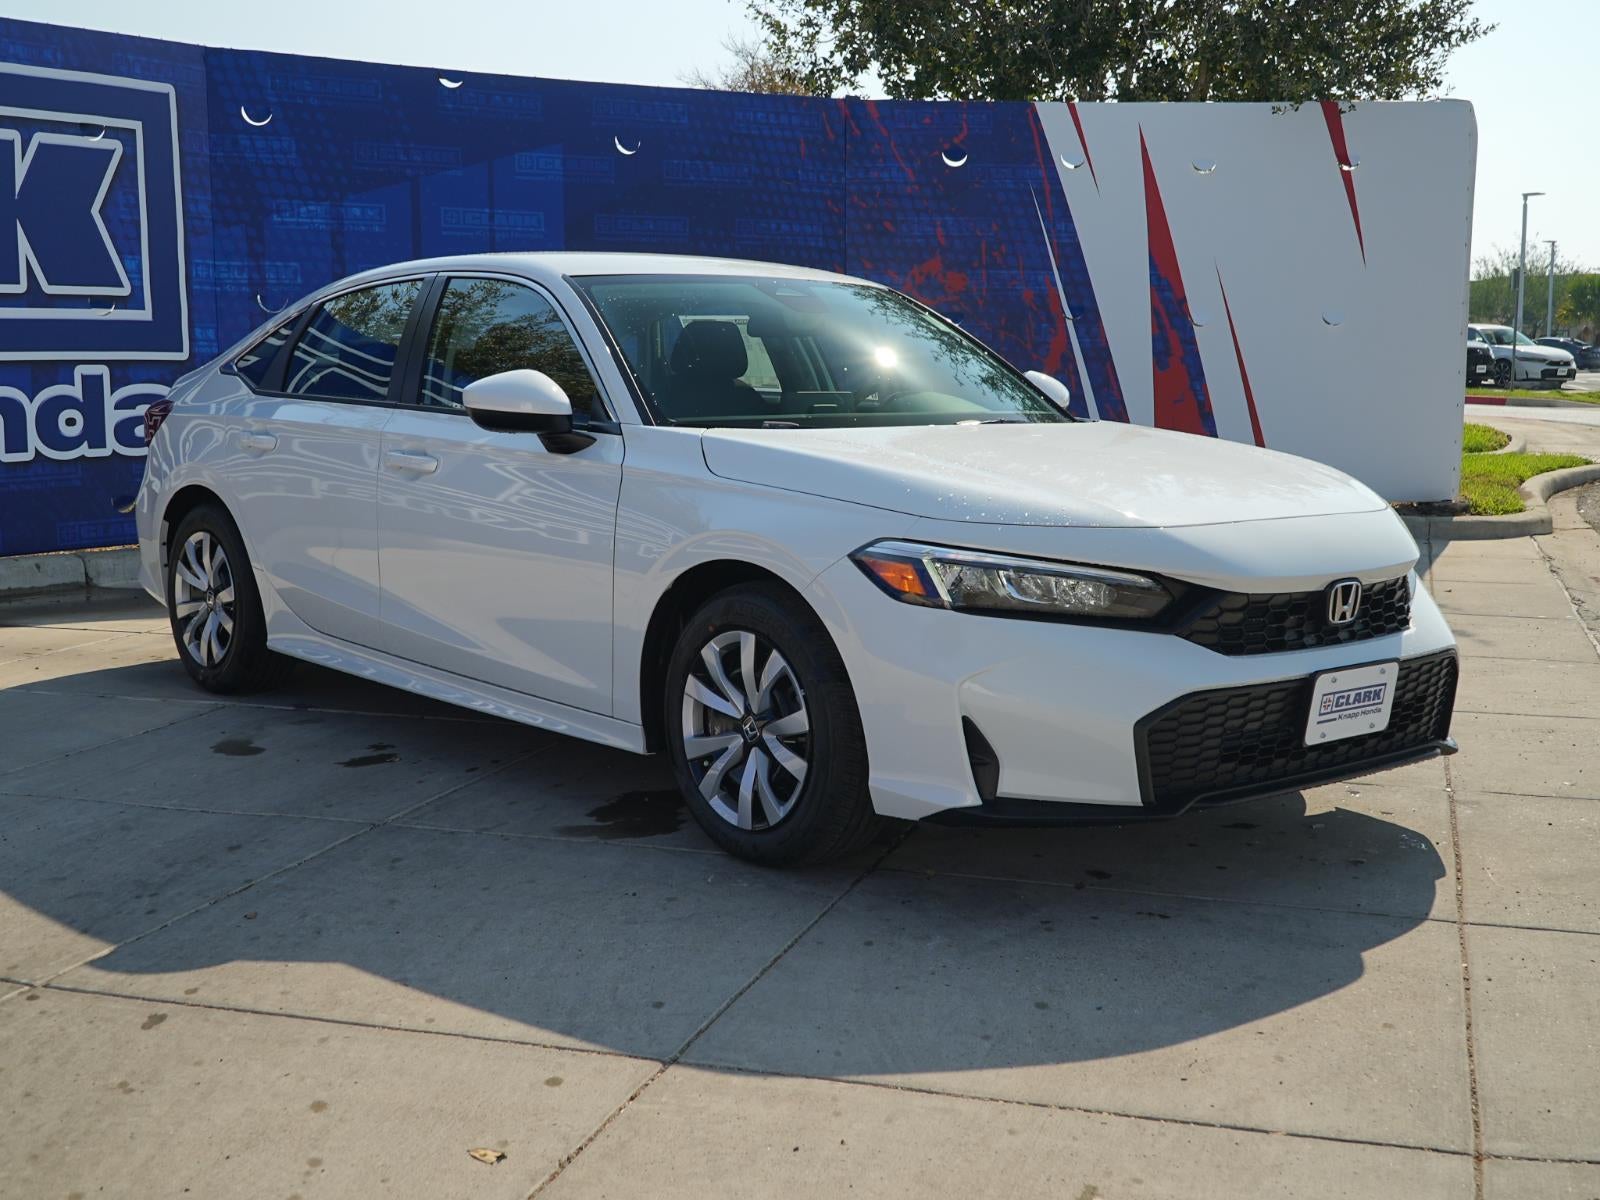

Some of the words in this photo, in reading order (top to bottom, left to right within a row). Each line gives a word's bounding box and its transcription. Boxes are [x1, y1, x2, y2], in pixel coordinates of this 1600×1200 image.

[1334, 688, 1382, 709] CLARK
[1338, 712, 1360, 721] Knapp
[1360, 706, 1382, 716] Honda
